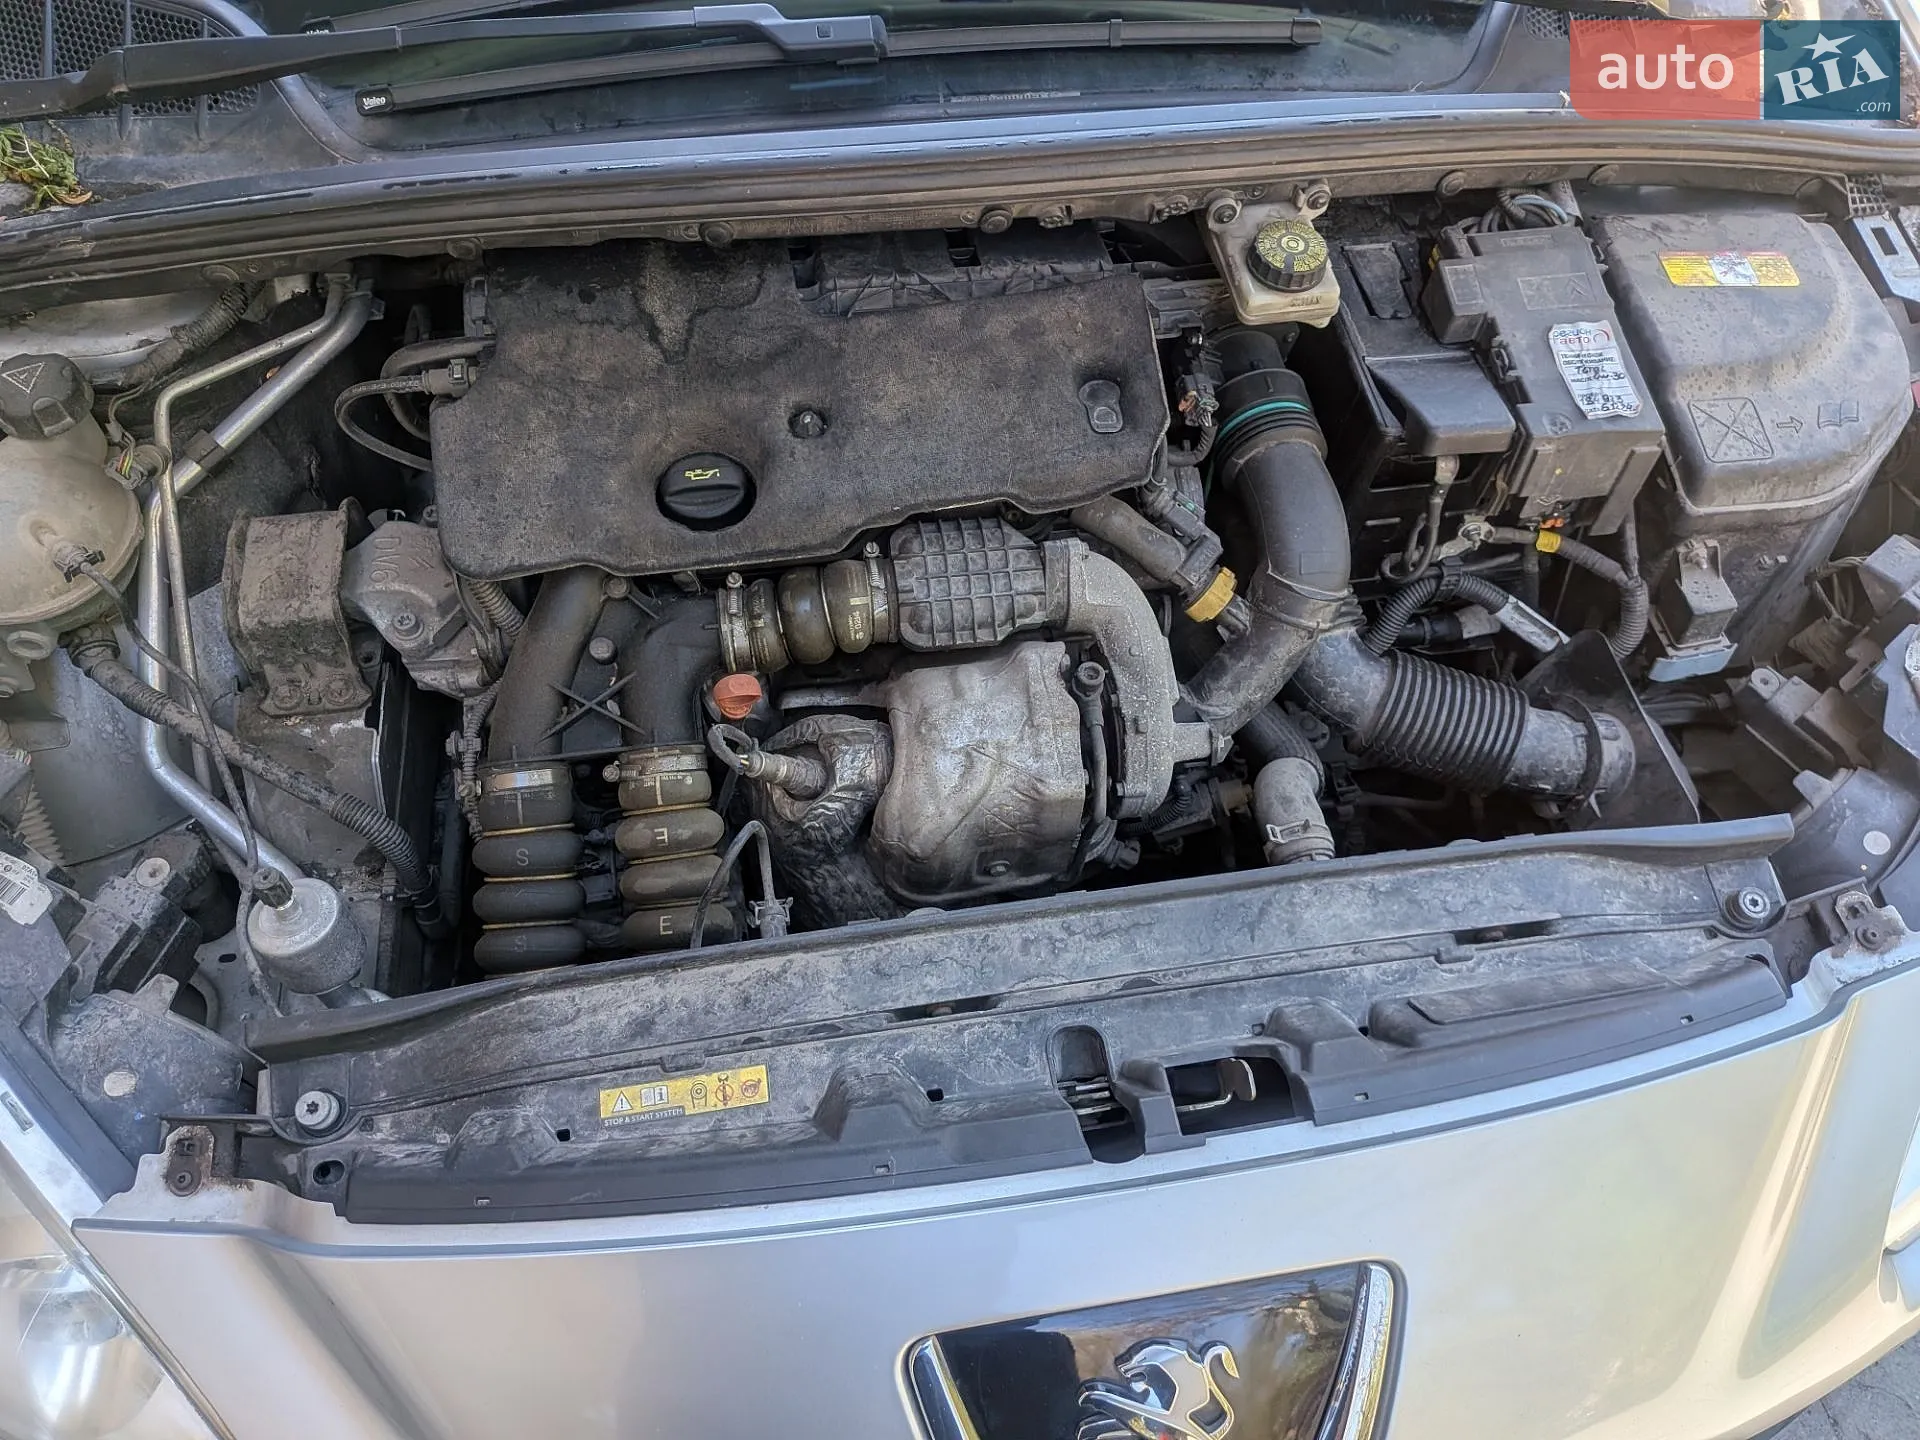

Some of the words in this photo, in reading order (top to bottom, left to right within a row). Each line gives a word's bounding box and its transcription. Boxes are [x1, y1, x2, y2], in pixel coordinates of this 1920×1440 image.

[516, 848, 529, 866] S
[659, 915, 673, 935] E
[604, 1117, 623, 1127] STOP
[631, 1113, 653, 1122] START
[655, 1108, 683, 1118] SYSTEM
